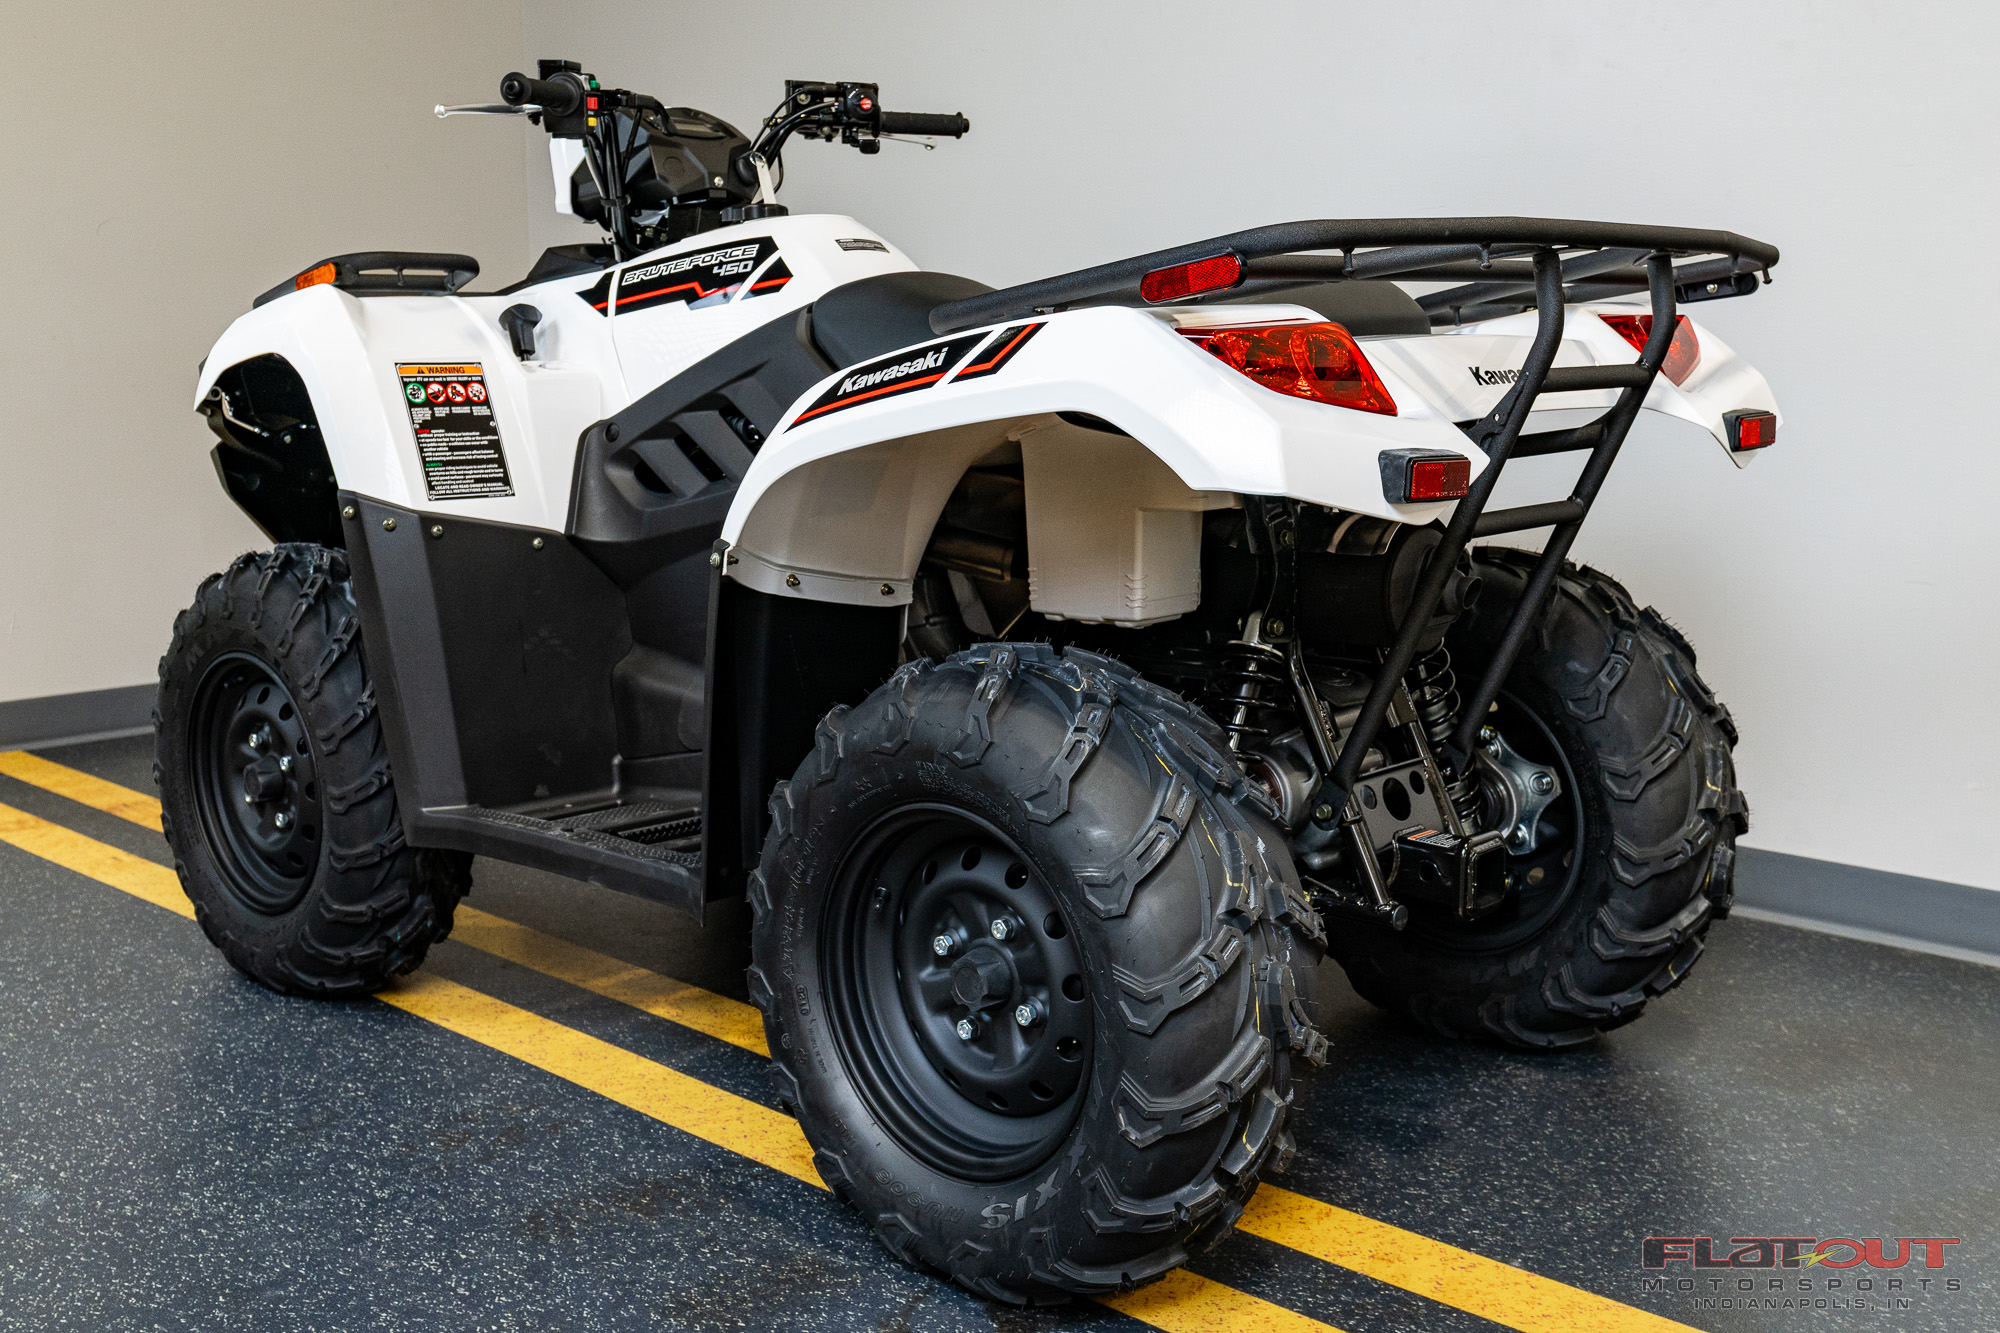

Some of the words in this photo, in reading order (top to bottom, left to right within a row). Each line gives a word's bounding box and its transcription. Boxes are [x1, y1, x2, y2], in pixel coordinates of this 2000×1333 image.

[713, 260, 753, 276] 450
[426, 366, 466, 374] WARNING
[837, 346, 949, 396] Kawasaki
